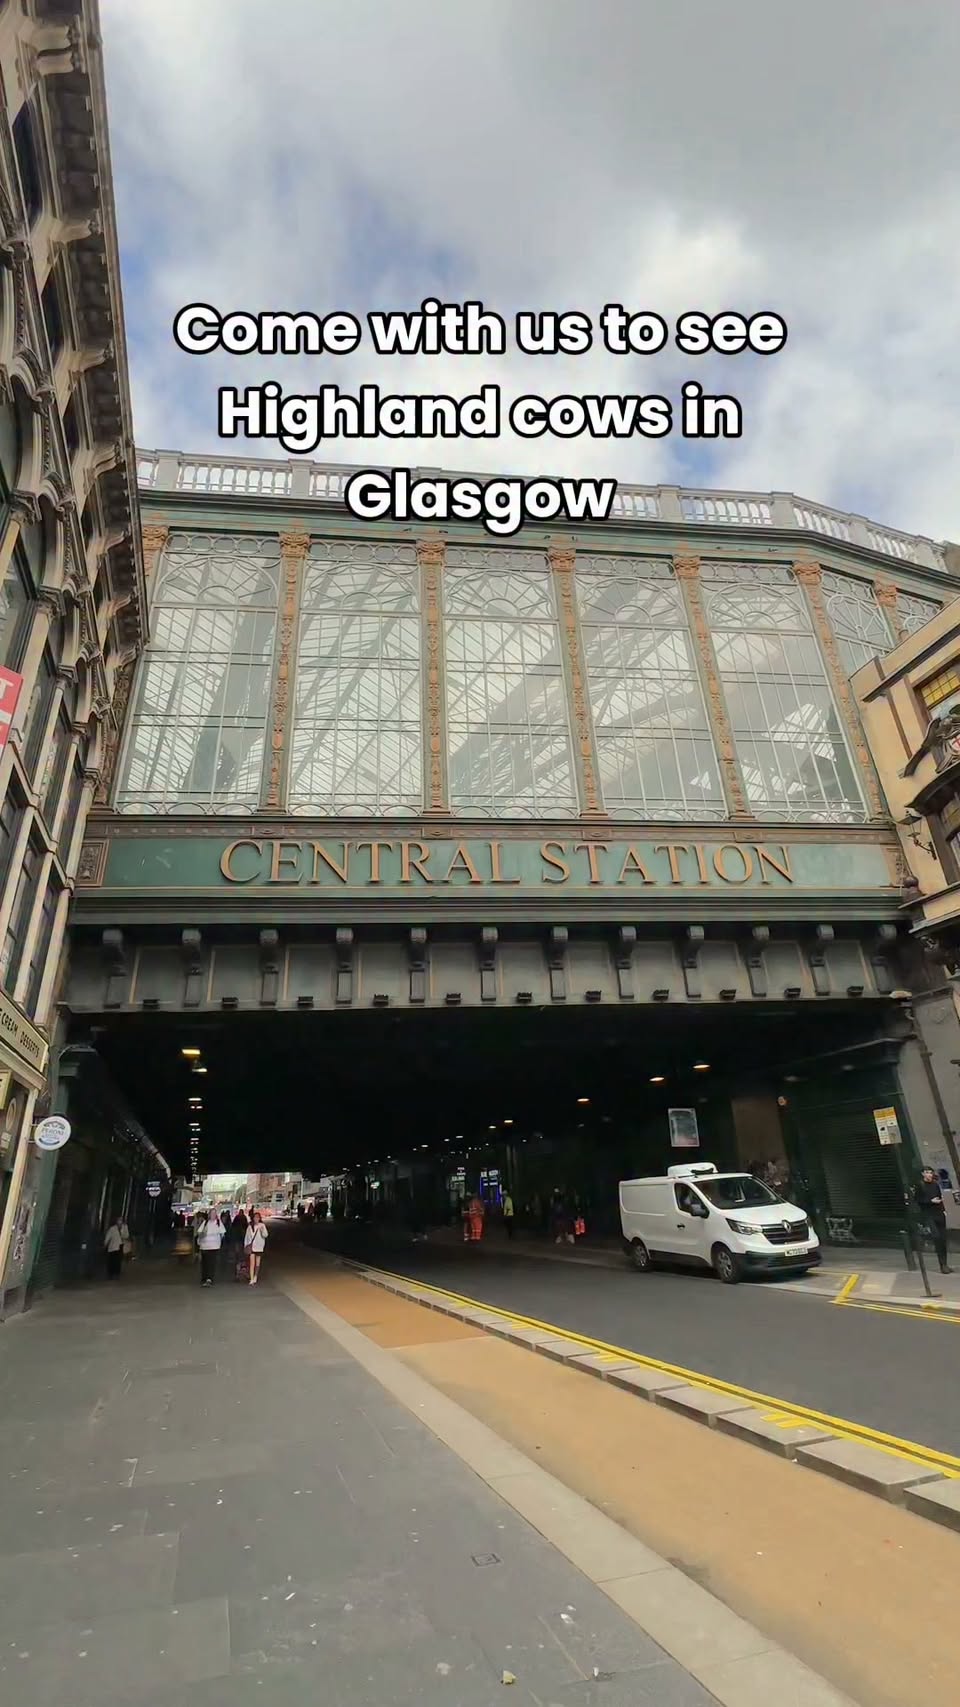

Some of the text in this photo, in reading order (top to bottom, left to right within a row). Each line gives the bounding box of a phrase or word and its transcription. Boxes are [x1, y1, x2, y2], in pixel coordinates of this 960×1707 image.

[219, 838, 796, 886] CENTRAL STATION
[19, 1031, 40, 1058] DESSERTS
